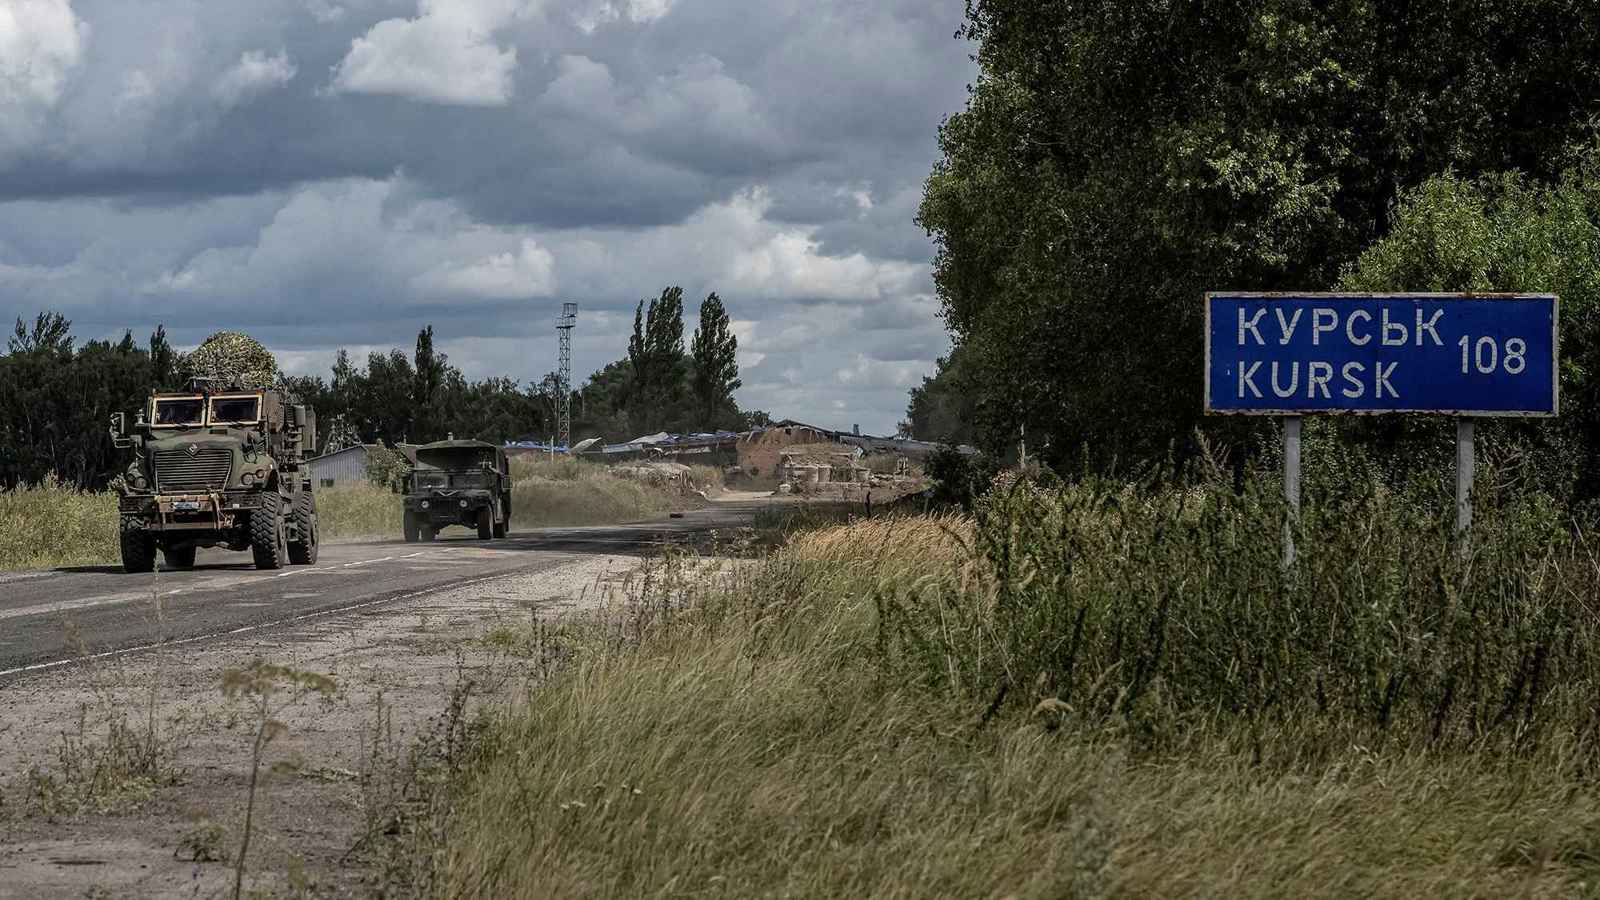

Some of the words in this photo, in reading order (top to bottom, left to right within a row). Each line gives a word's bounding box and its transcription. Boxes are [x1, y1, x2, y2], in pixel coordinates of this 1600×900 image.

[1238, 307, 1445, 346] КУРСЬК
[1458, 335, 1527, 374] 108
[1238, 361, 1400, 399] KURSK
